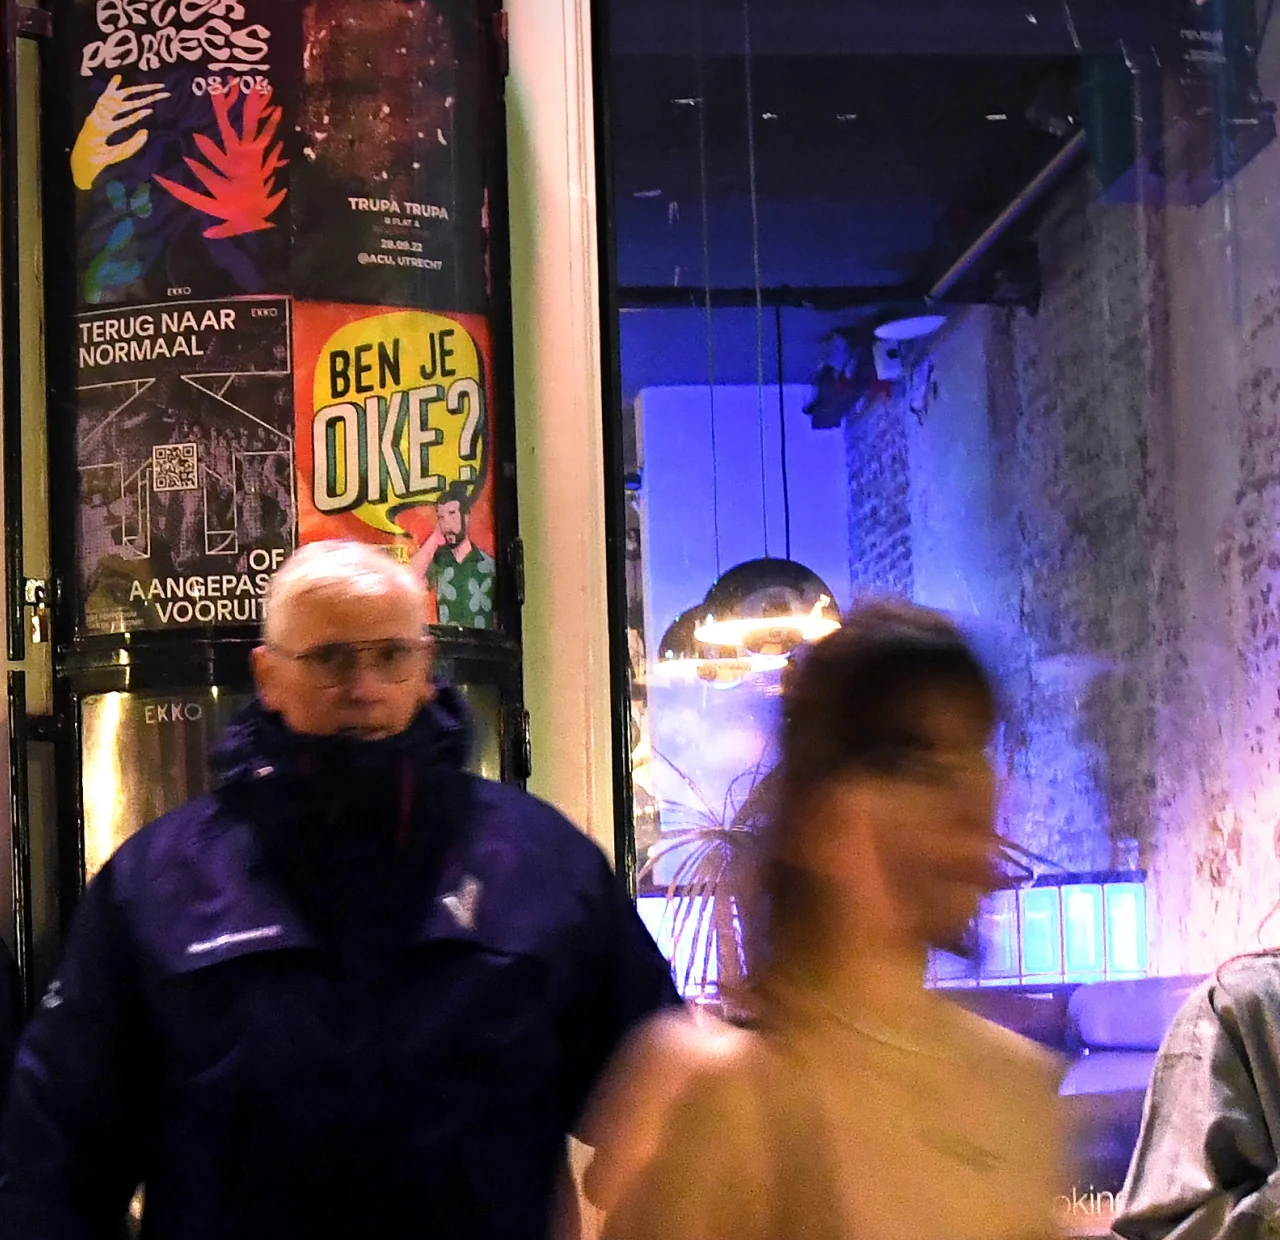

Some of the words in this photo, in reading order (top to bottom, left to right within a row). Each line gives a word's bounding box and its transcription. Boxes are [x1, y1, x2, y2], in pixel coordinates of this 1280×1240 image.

[348, 197, 401, 213] TRUPA
[403, 201, 449, 220] TRUPA
[397, 255, 443, 270] UTRECHT
[251, 307, 278, 318] EKKO
[79, 314, 154, 344] TERUG
[161, 308, 236, 334] NAAR
[79, 334, 204, 369] NORMAAL
[329, 338, 401, 399] BEN
[420, 328, 457, 380] JE
[312, 376, 485, 516] OKE?
[249, 548, 285, 571] OF
[128, 573, 276, 602] AANGEPAS
[145, 703, 203, 724] EKKO
